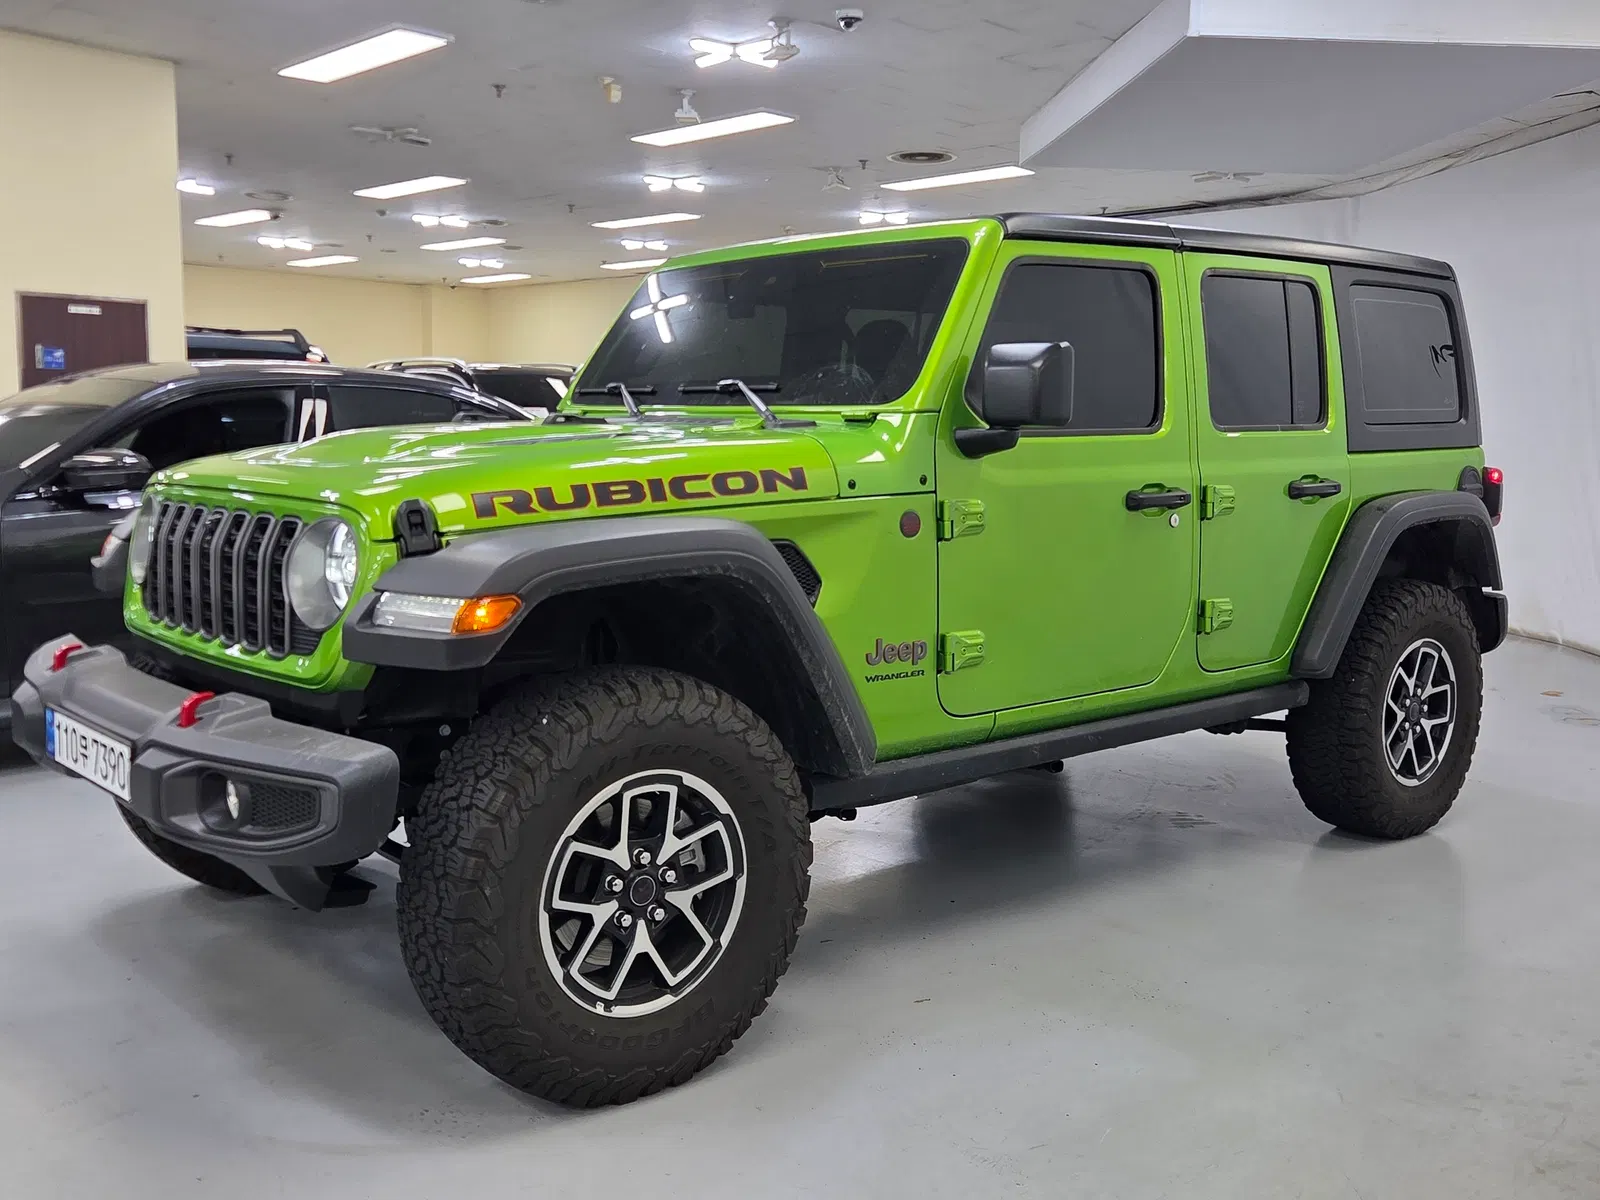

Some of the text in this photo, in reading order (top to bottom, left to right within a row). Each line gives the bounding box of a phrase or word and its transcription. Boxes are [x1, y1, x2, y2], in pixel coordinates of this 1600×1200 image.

[470, 467, 808, 519] RUBICON
[865, 637, 928, 666] Jeep
[864, 669, 925, 684] WRANGLER
